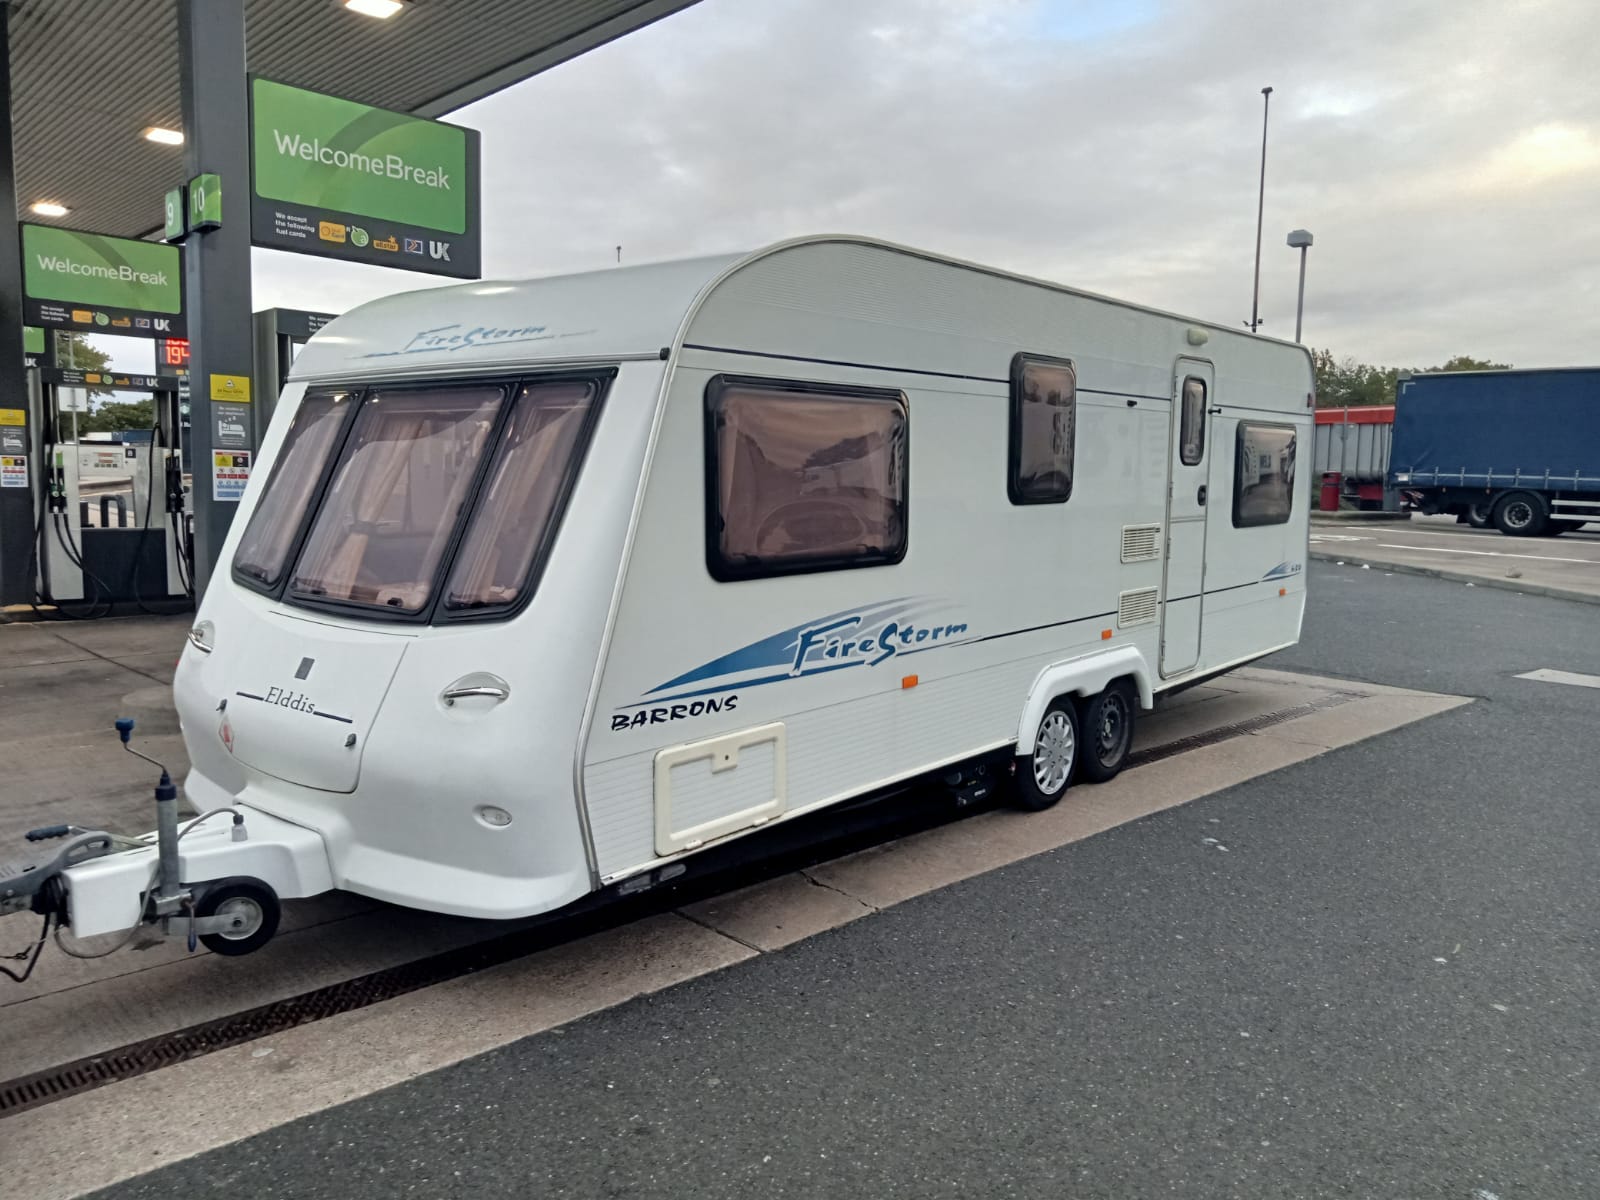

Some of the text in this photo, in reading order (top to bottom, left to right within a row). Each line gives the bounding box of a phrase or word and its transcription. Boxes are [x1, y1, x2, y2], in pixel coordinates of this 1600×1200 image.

[273, 128, 450, 190] WelcomeBreak
[167, 202, 174, 227] 9
[192, 186, 205, 214] 10
[429, 240, 451, 262] UK
[37, 254, 168, 286] WelcomeBreak
[154, 318, 171, 332] UK
[403, 324, 547, 351] FireStorm
[788, 616, 968, 677] FireStorm
[265, 686, 317, 722] Elddis
[611, 695, 739, 732] BARRONS
